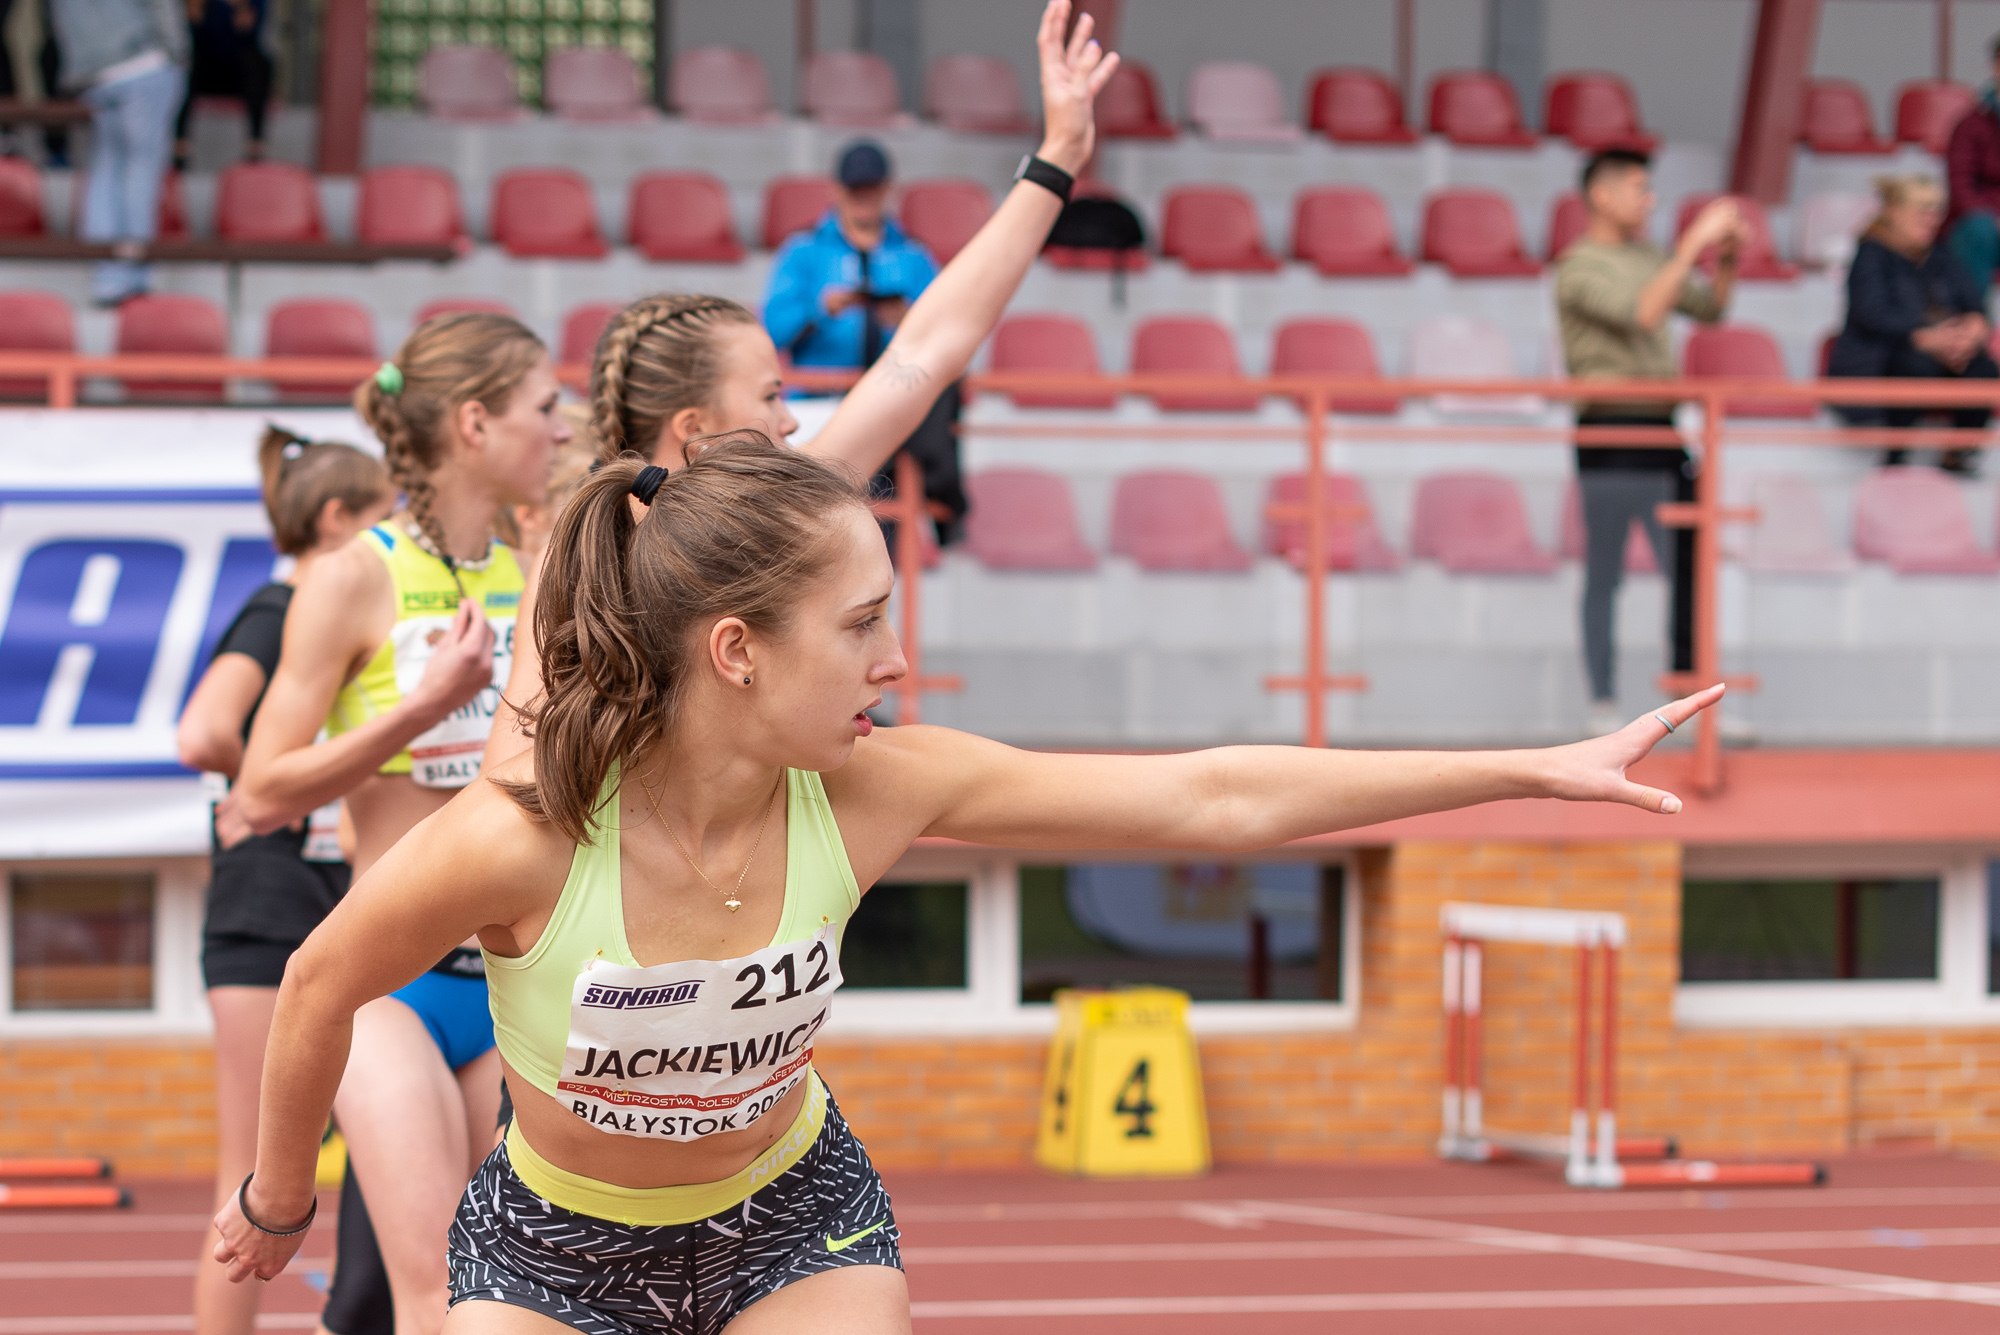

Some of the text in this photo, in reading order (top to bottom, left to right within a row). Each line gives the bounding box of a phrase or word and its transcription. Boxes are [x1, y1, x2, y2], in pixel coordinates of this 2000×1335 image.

[582, 981, 700, 1010] SONAROL
[731, 941, 830, 1010] 212
[574, 1006, 826, 1079] JACKIEWICZ
[566, 1083, 600, 1095] PZLA
[602, 1090, 695, 1107] MISTRZOSTWA
[697, 1096, 740, 1108] POLSKI
[572, 1077, 799, 1136] BIAŁYSTOK 2022
[1114, 1056, 1157, 1138] 4
[750, 1126, 808, 1184] NIKE
